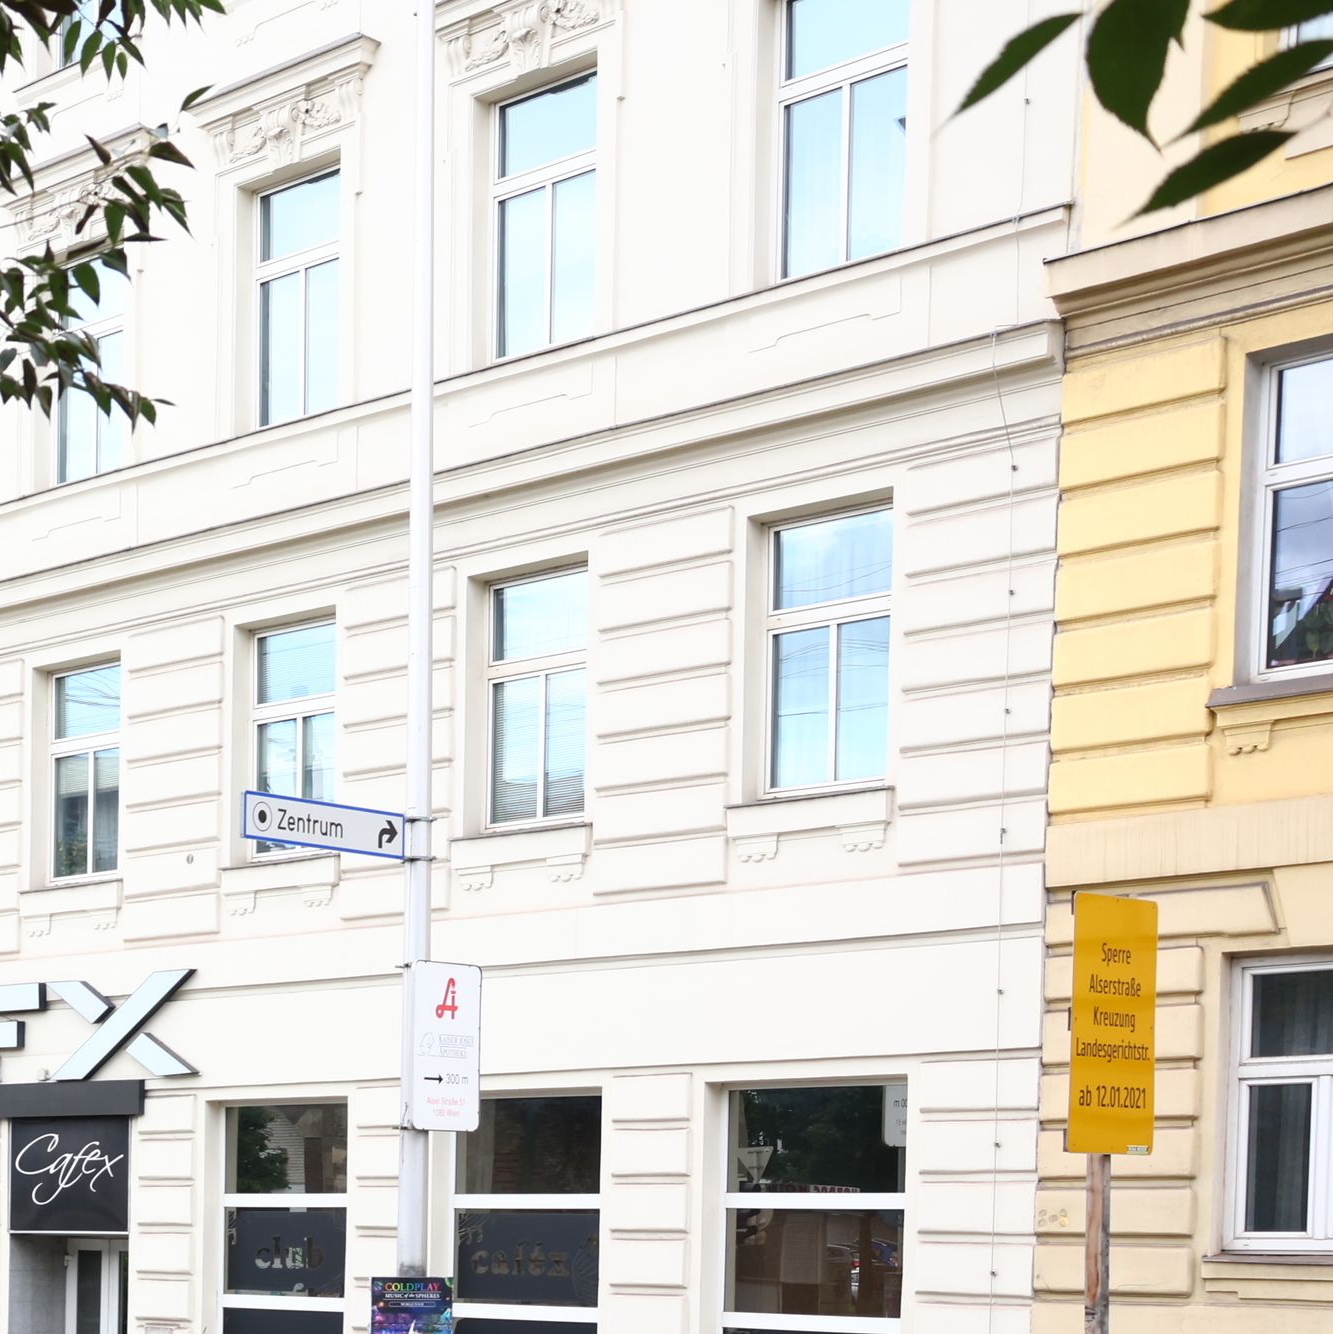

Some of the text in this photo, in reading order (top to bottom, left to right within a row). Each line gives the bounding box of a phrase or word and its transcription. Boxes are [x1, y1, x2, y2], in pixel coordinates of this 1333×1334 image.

[277, 809, 343, 838] Zentrum
[1101, 943, 1131, 965] Sperre
[1089, 974, 1141, 997] Alserstraße
[1093, 1006, 1136, 1032] Kreuzung
[1076, 1038, 1150, 1063] Landesgerichtstr.
[445, 1073, 469, 1085] 300 m
[1078, 1085, 1146, 1109] ab 12.01.2021
[255, 1236, 324, 1270] club
[385, 1283, 440, 1291] COLDPLAY
